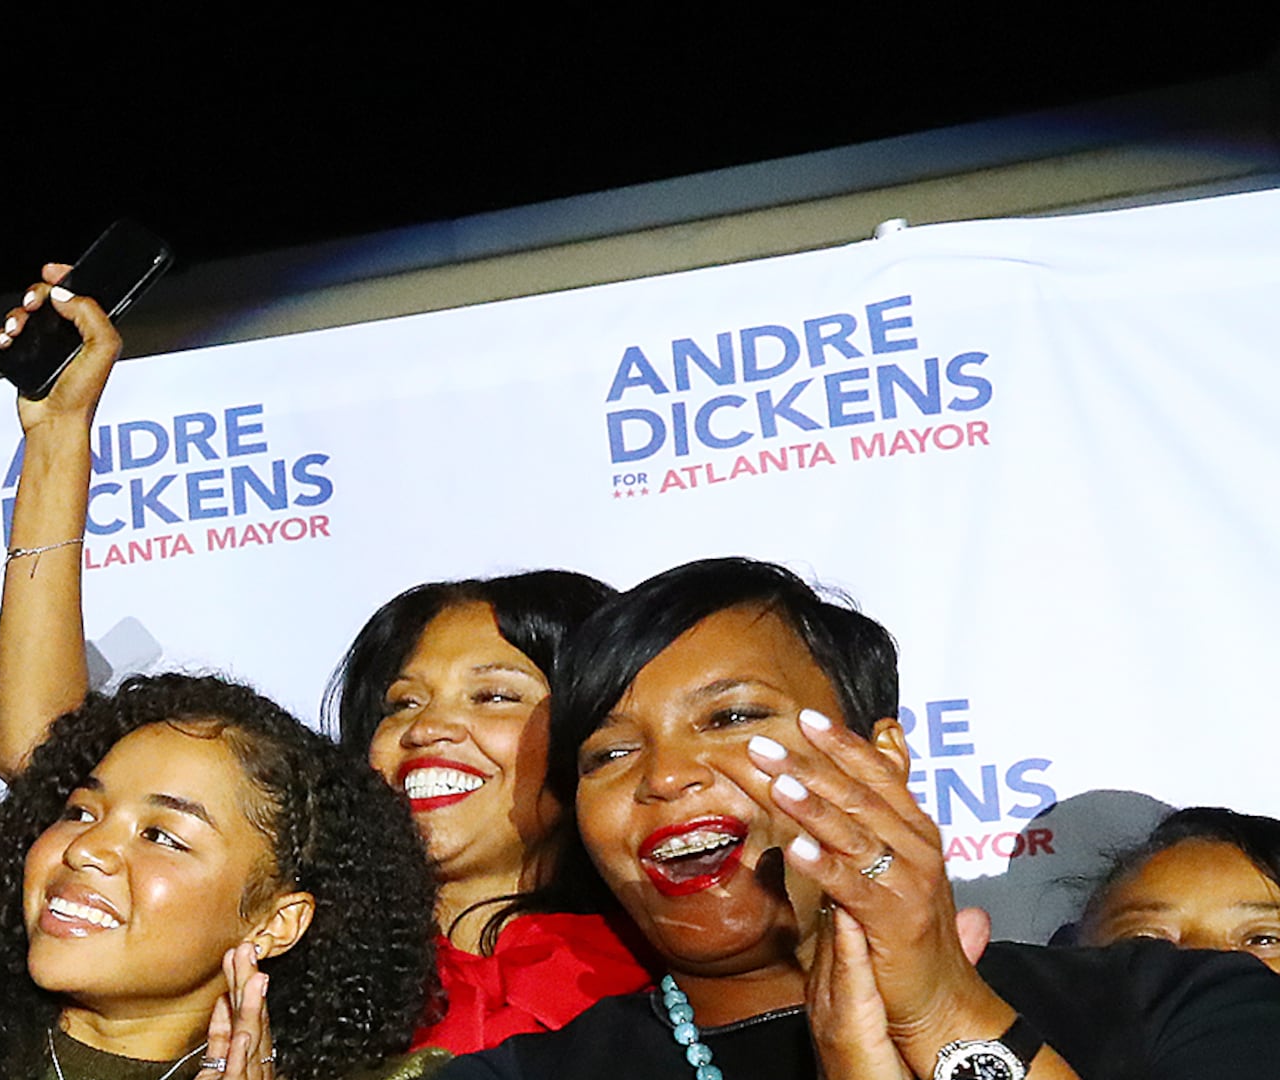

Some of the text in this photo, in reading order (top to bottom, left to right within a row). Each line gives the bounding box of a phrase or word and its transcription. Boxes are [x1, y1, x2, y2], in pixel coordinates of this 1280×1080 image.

[606, 295, 918, 402] ANDRE
[2, 404, 268, 489] DRE
[606, 352, 993, 464] DICKENS
[612, 421, 990, 493] FOR ATLANTA MAYOR
[2, 453, 334, 548] CKENS
[85, 515, 331, 570] LANTA MAYOR
[944, 828, 1055, 862] AYOR
